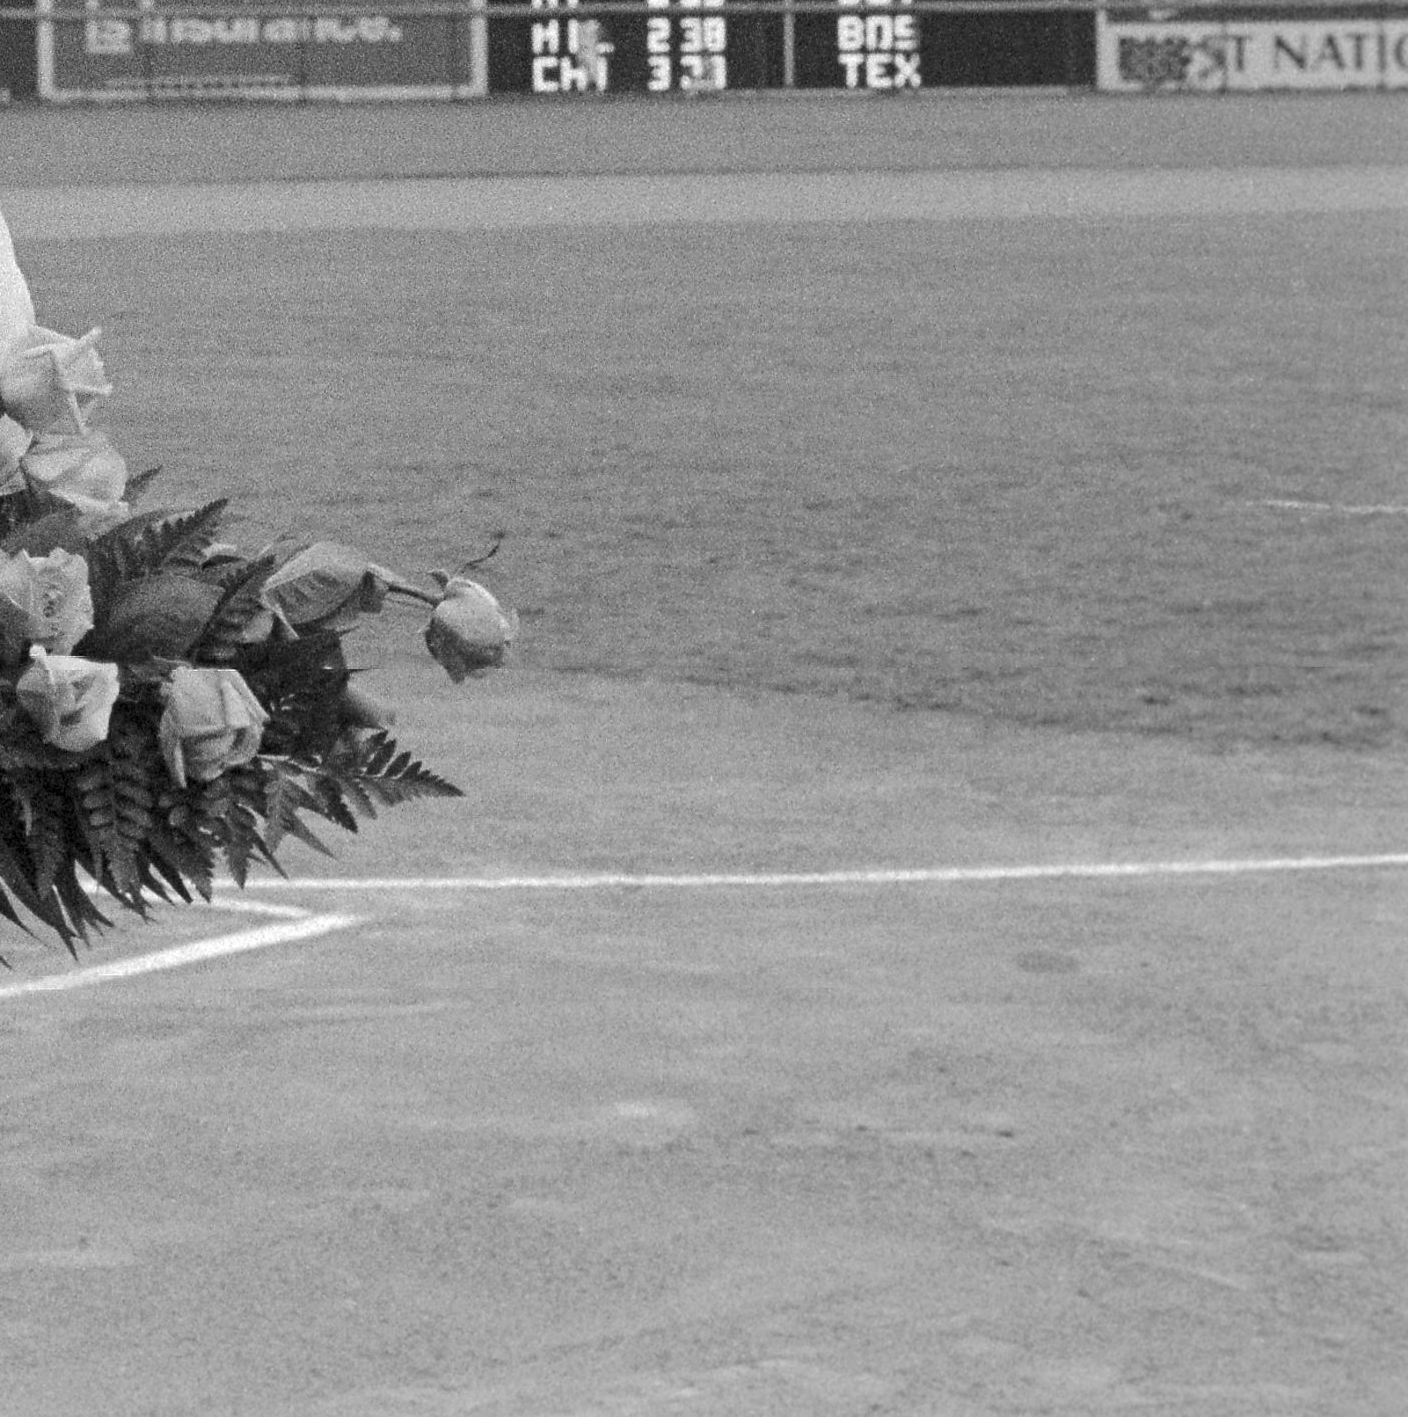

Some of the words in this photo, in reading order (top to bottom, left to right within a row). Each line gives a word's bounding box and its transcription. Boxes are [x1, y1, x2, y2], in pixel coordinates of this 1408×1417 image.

[647, 17, 671, 54] 2
[837, 14, 919, 52] BOS
[647, 55, 671, 91] 3
[837, 52, 922, 89] TEX
